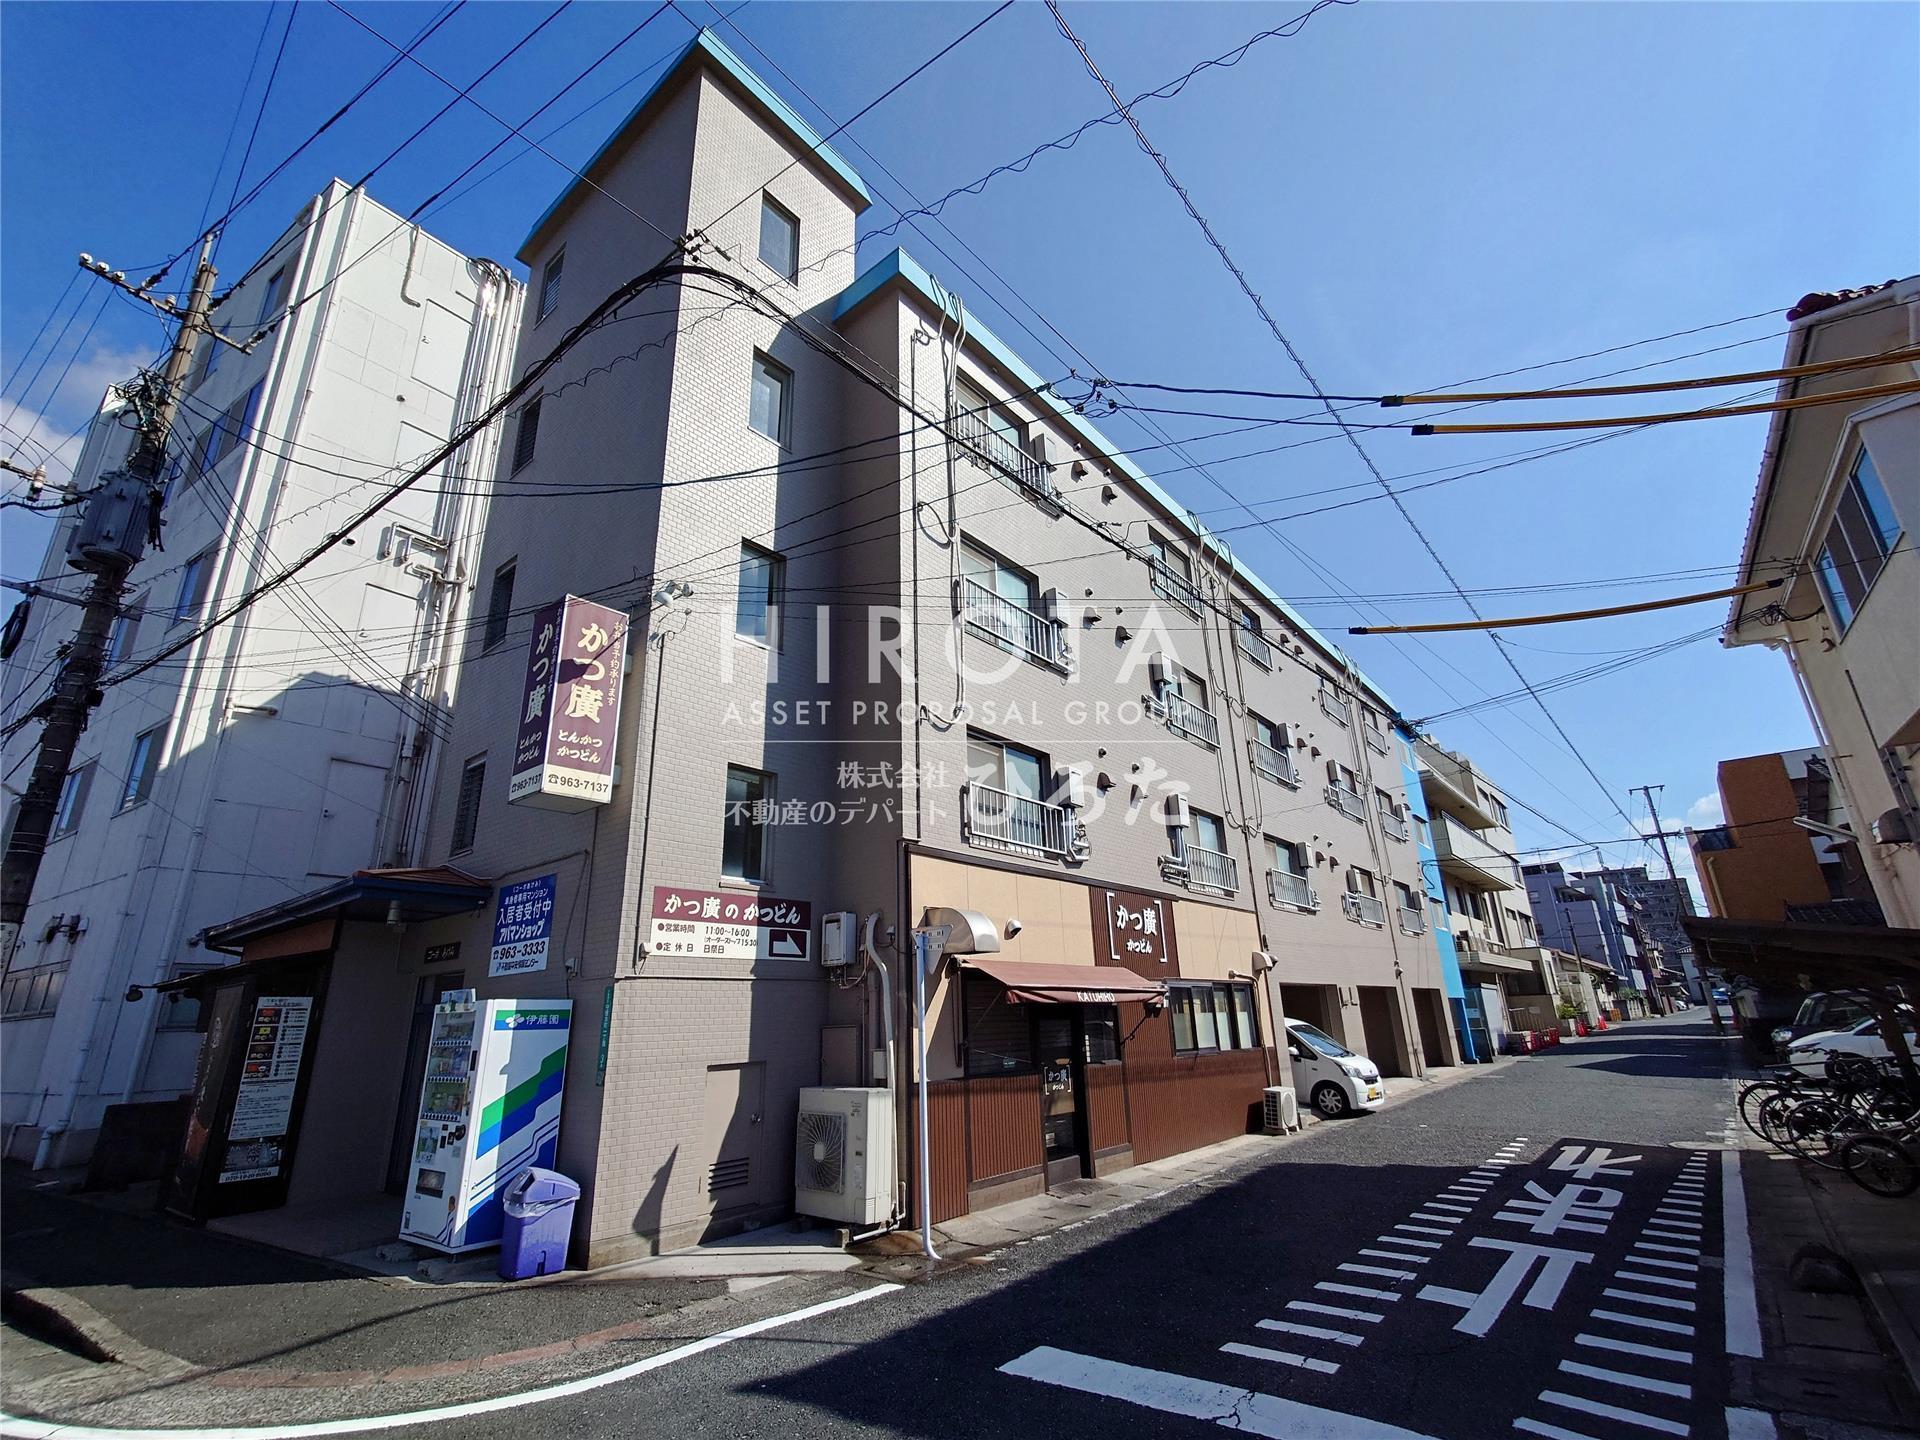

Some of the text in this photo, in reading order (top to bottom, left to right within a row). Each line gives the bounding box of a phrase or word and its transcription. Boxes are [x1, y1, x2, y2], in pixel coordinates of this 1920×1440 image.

[524, 623, 553, 724] かつ廣
[564, 622, 609, 724] かつ廣
[558, 729, 603, 748] とんかつ
[556, 745, 601, 764] かつどん
[560, 776, 609, 793] 963-7137
[497, 897, 552, 926] 入居者受付中
[663, 893, 801, 926] かつ廣のかつどん
[665, 923, 695, 934] 営業時間
[1116, 904, 1158, 937] かつ廣
[499, 918, 545, 944] アパマンショップ
[500, 941, 546, 960] 963-3333
[1126, 937, 1153, 955] かつどん
[525, 1014, 560, 1025] 伊藤園
